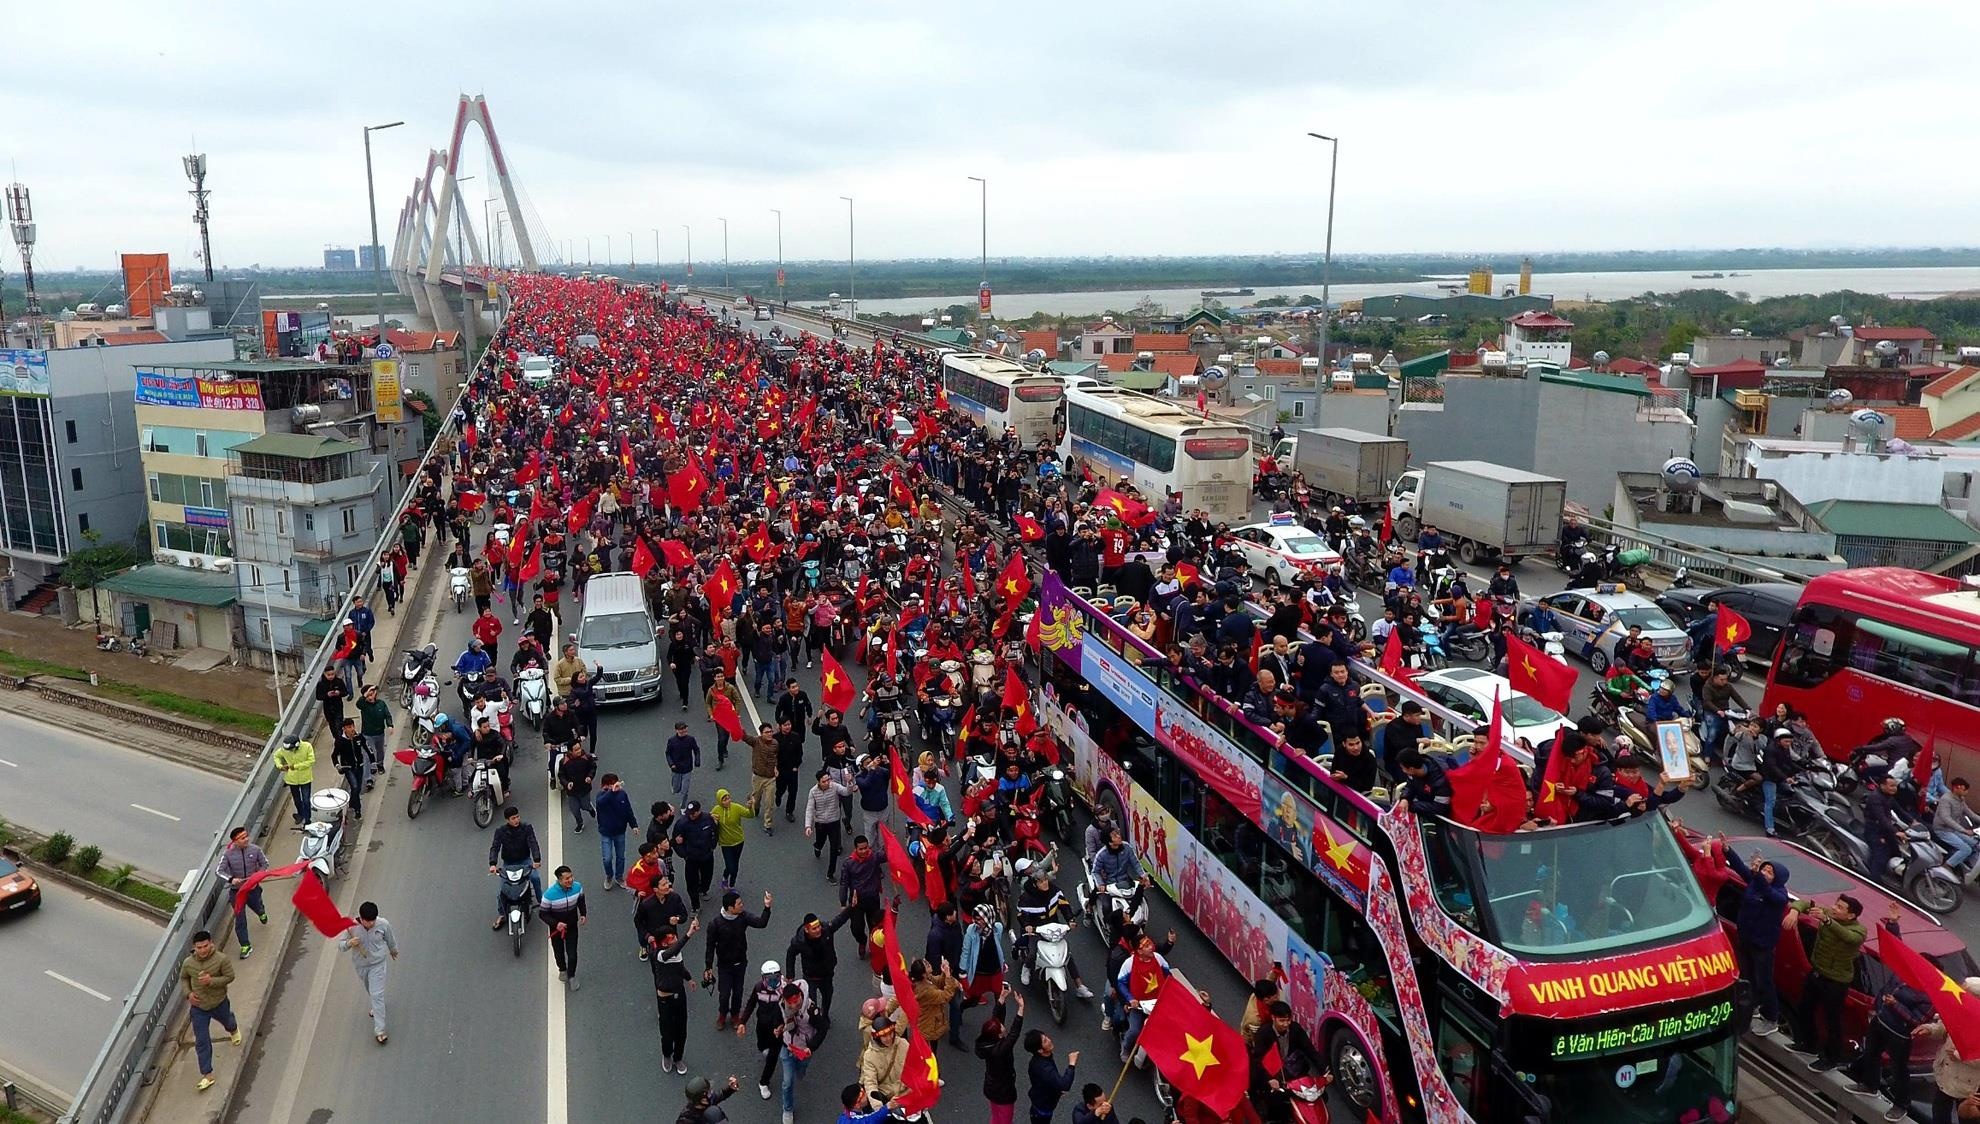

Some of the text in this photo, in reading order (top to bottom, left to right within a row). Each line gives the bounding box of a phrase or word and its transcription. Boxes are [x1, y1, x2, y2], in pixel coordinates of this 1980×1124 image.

[1113, 538, 1124, 553] 19
[1528, 950, 1734, 1004] VINH QUANG VIỆT NAM
[1570, 1033, 1594, 1053] Văn
[1620, 1071, 1632, 1083] N1
